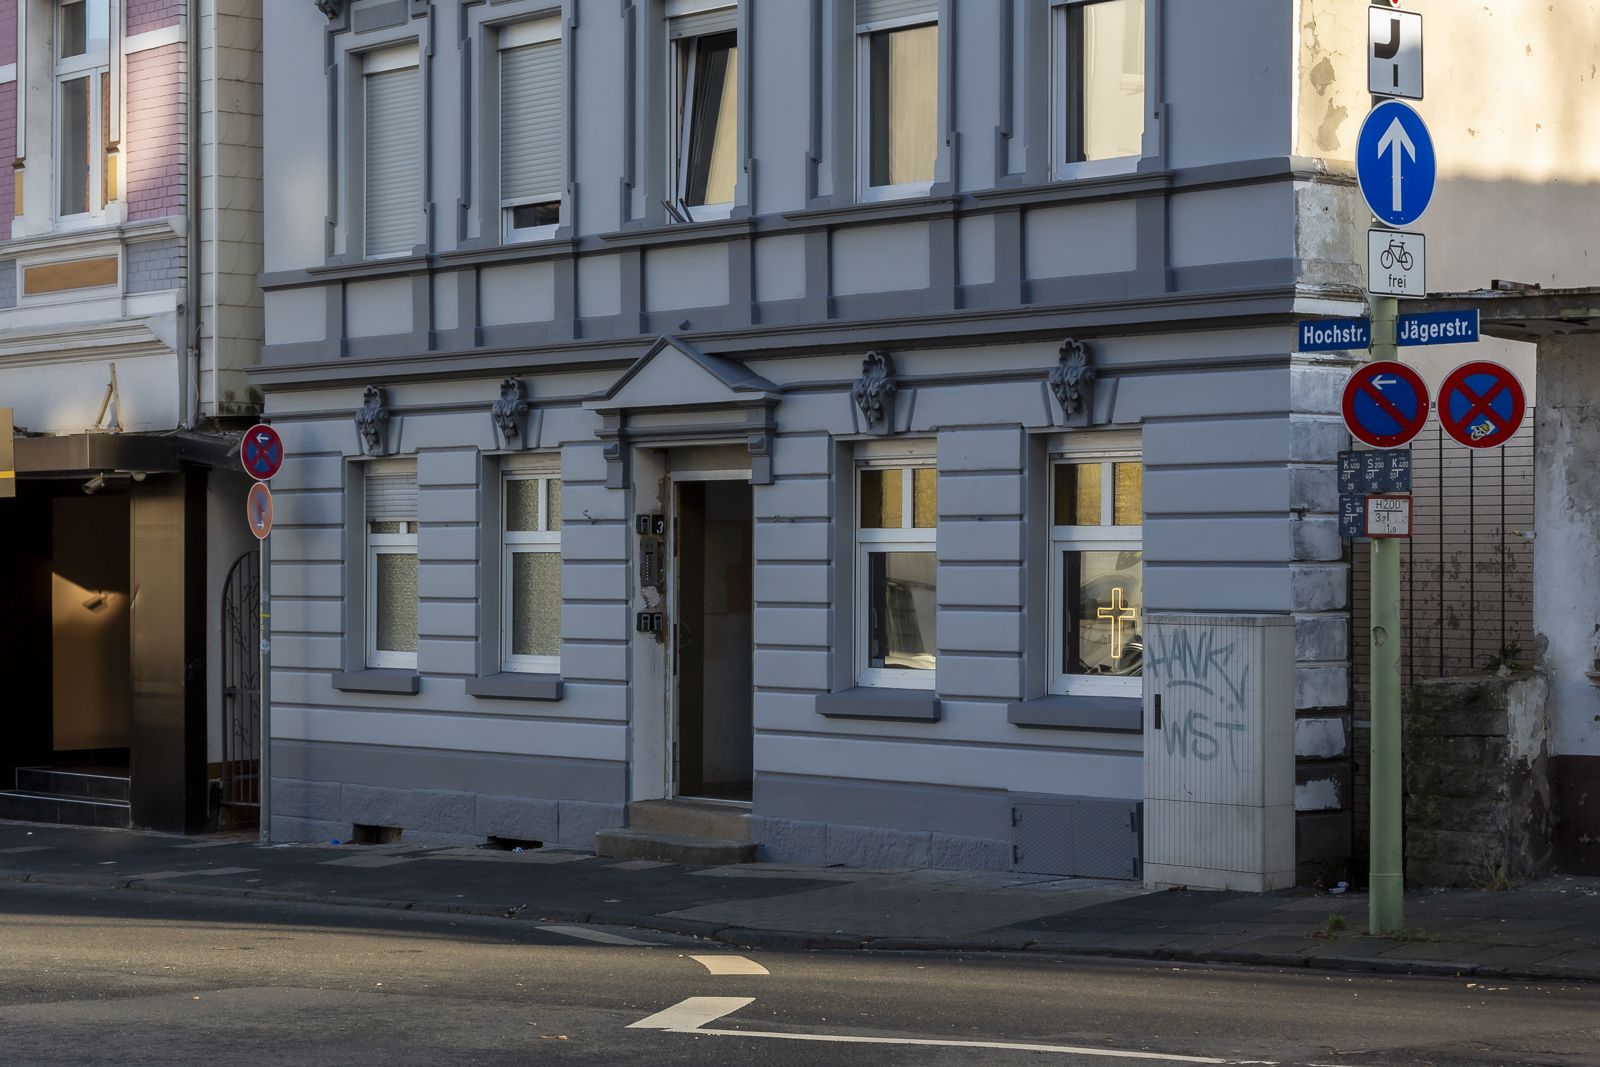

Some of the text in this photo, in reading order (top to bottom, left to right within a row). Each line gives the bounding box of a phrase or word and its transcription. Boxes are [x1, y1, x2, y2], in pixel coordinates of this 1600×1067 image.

[1388, 274, 1406, 288] frei
[1303, 325, 1367, 344] Hochstr.
[1400, 318, 1472, 342] Jägerstr.
[1343, 460, 1349, 469] K
[1367, 459, 1374, 469] S
[1392, 458, 1398, 468] K
[1345, 503, 1352, 513] S
[656, 520, 664, 534] 3
[1162, 709, 1246, 775] WST
